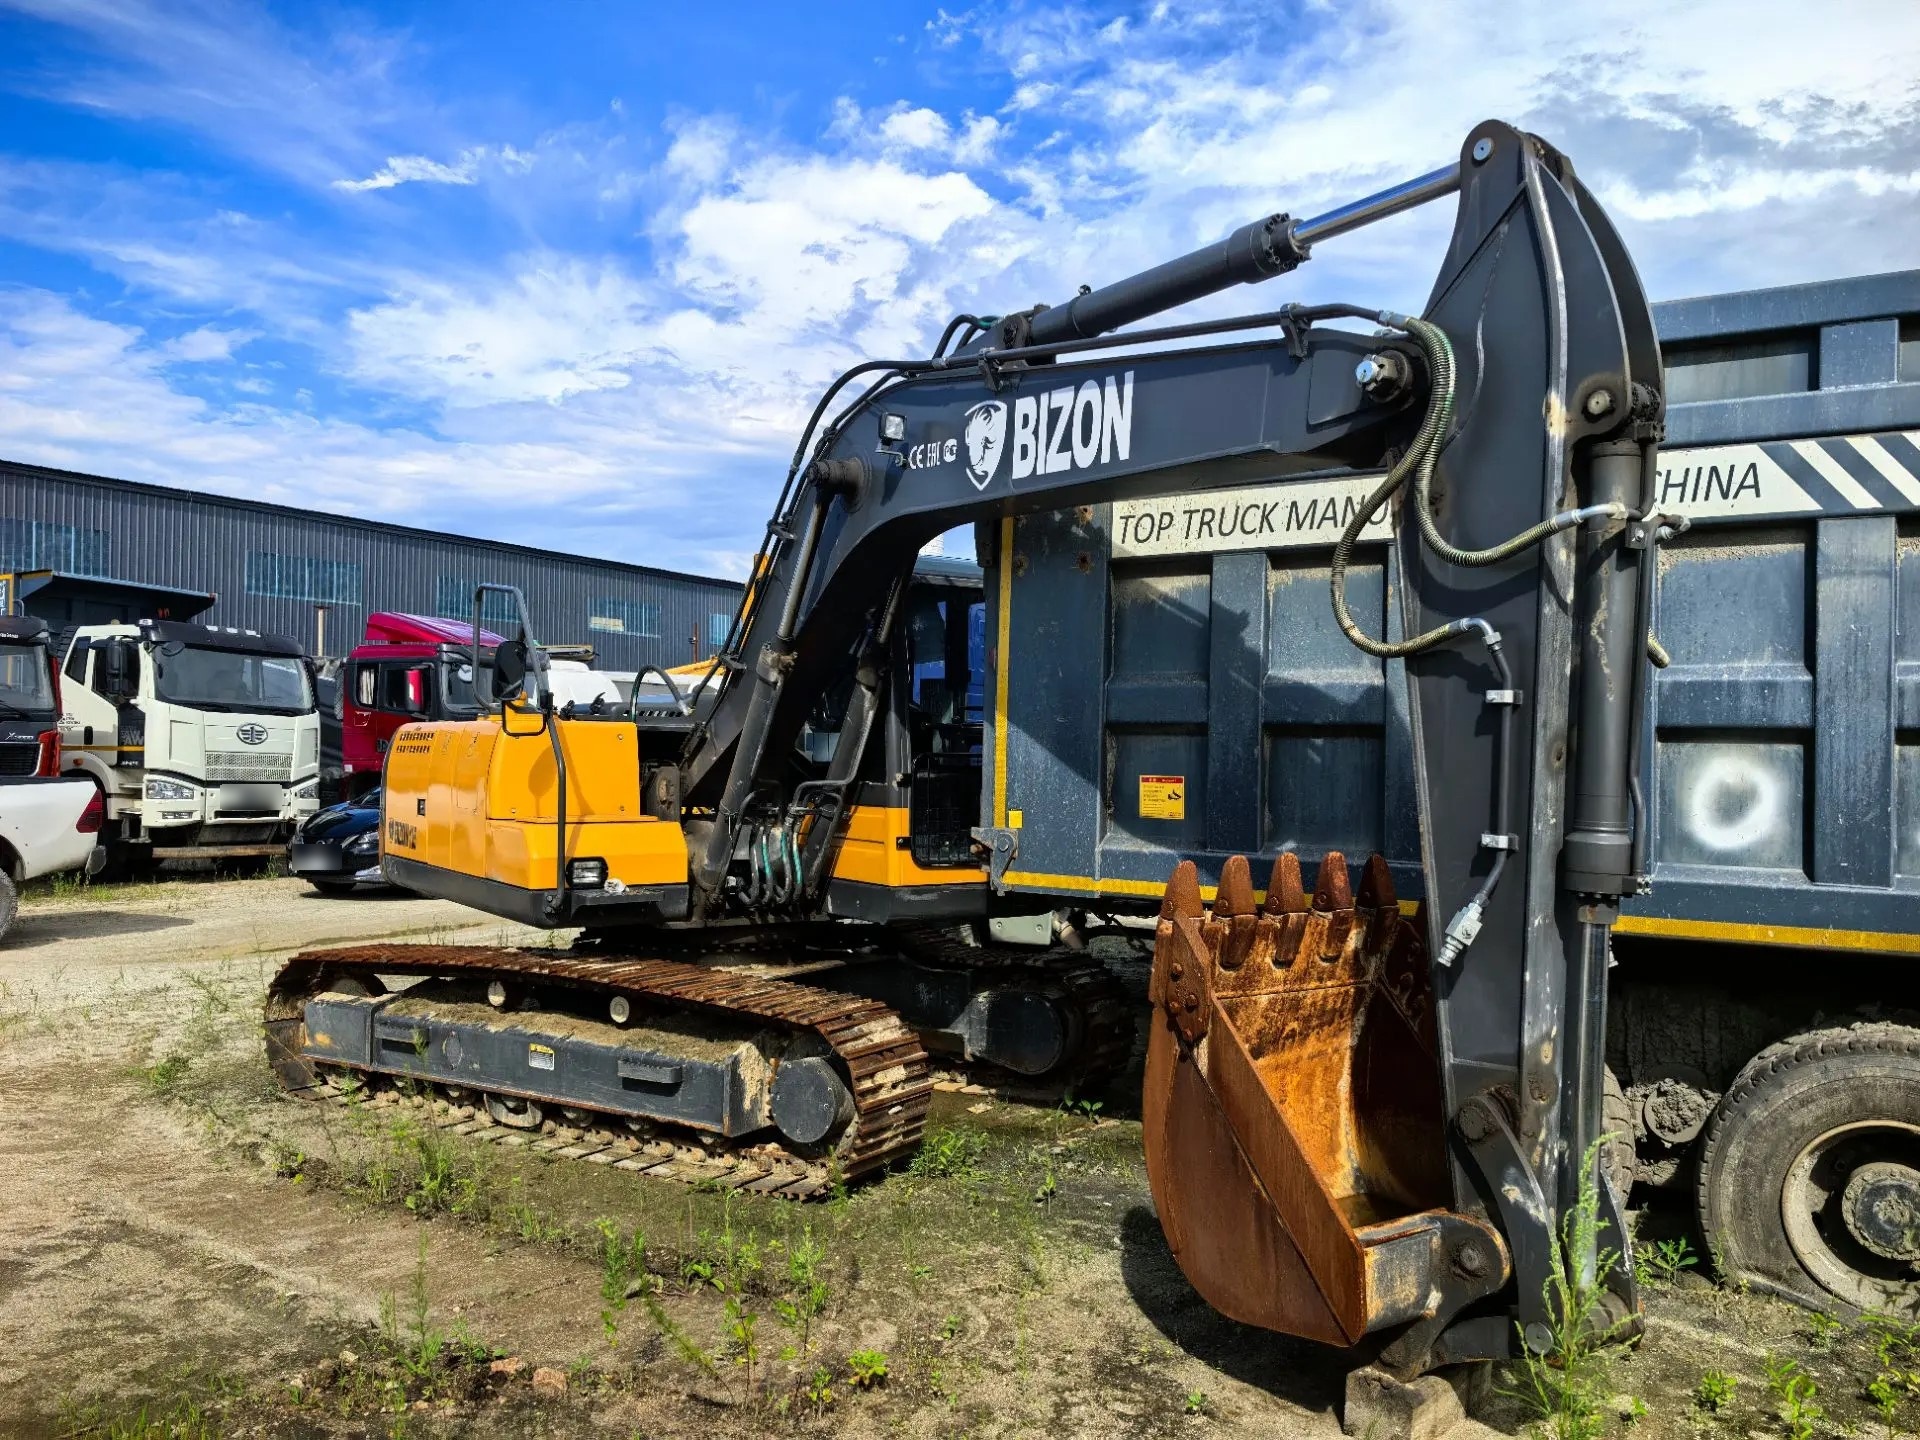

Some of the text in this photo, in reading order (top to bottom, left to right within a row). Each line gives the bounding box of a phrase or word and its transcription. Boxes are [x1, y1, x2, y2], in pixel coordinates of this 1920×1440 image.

[1012, 370, 1134, 480] BIZON
[908, 444, 925, 469] CE
[1655, 462, 1761, 504] HINA
[1119, 511, 1174, 544] TOP
[1183, 501, 1278, 540] TRUCK
